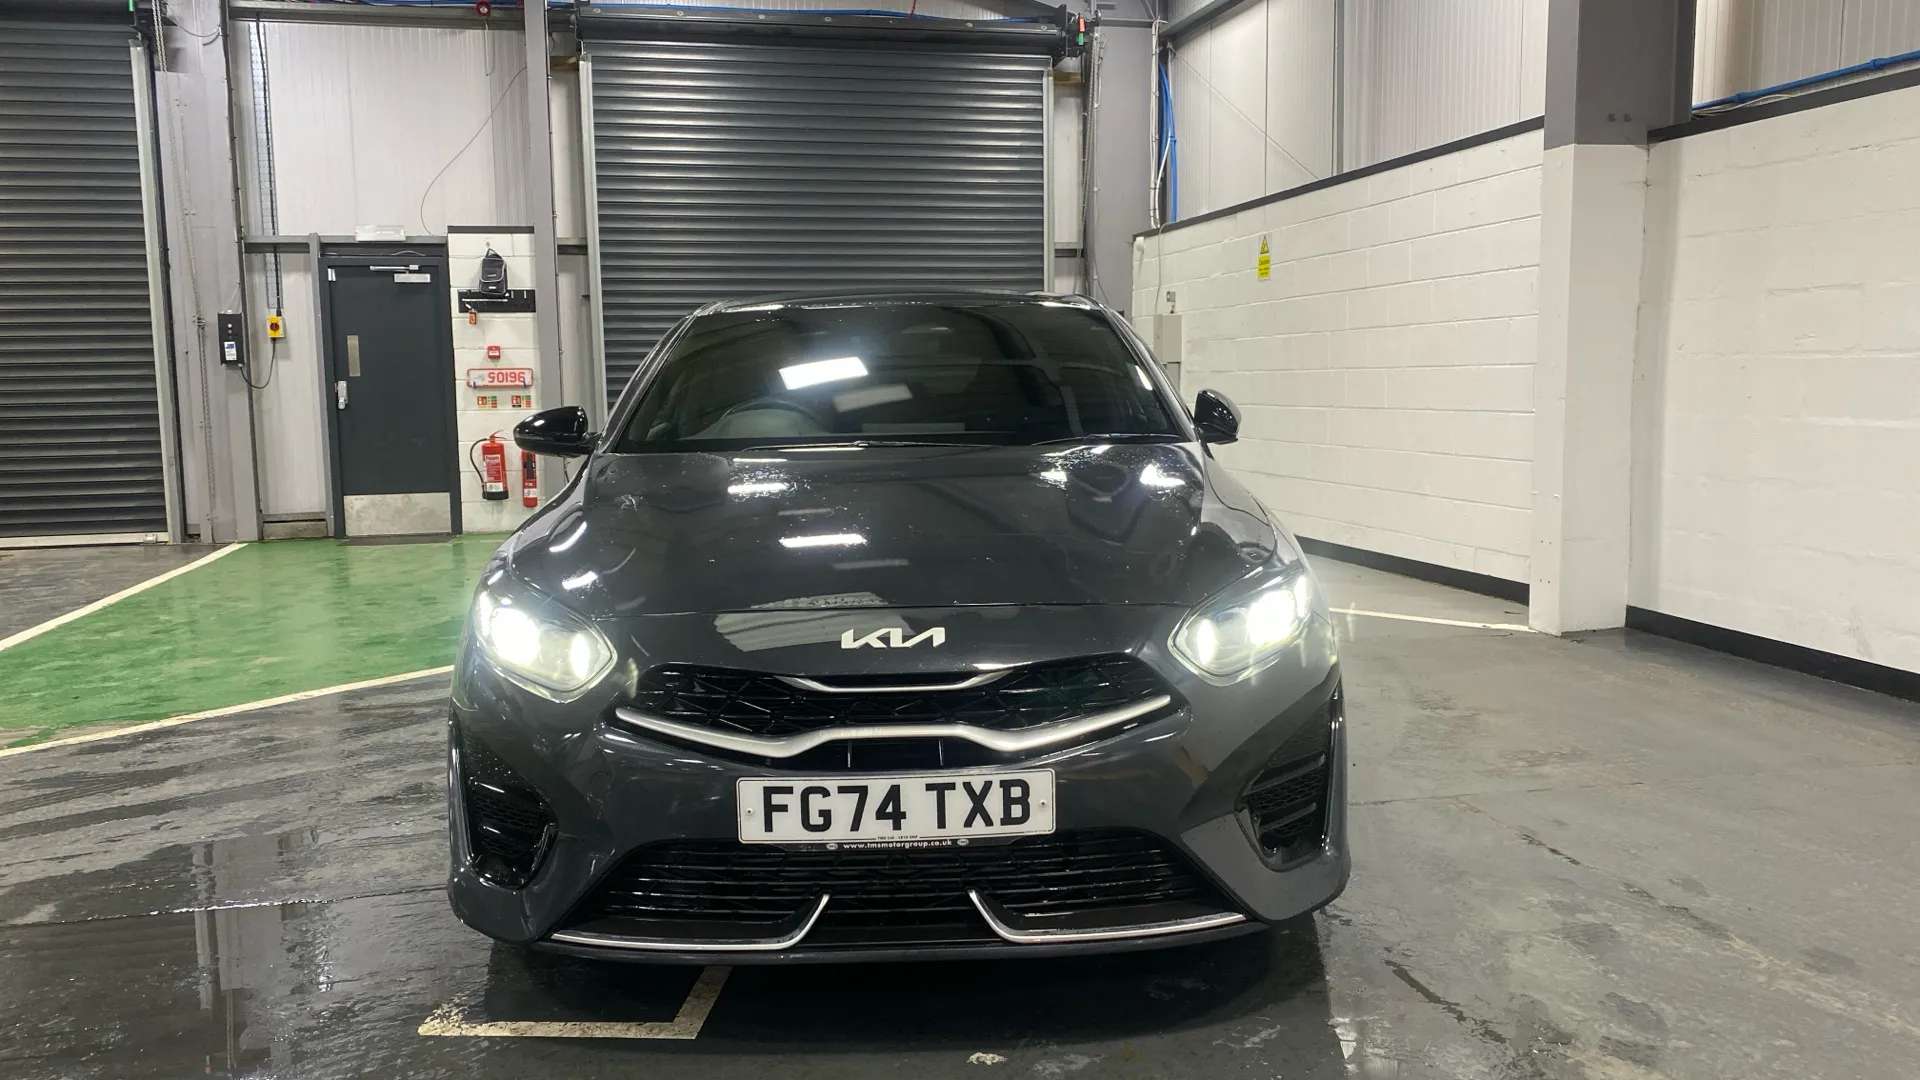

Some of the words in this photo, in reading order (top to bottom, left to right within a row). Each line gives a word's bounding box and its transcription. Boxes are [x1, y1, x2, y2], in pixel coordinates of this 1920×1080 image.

[841, 627, 946, 649] KIA
[762, 784, 907, 833] FG74
[925, 778, 1031, 830] TXB
[843, 839, 953, 849] www.tmsmotorgroup.co.uk
